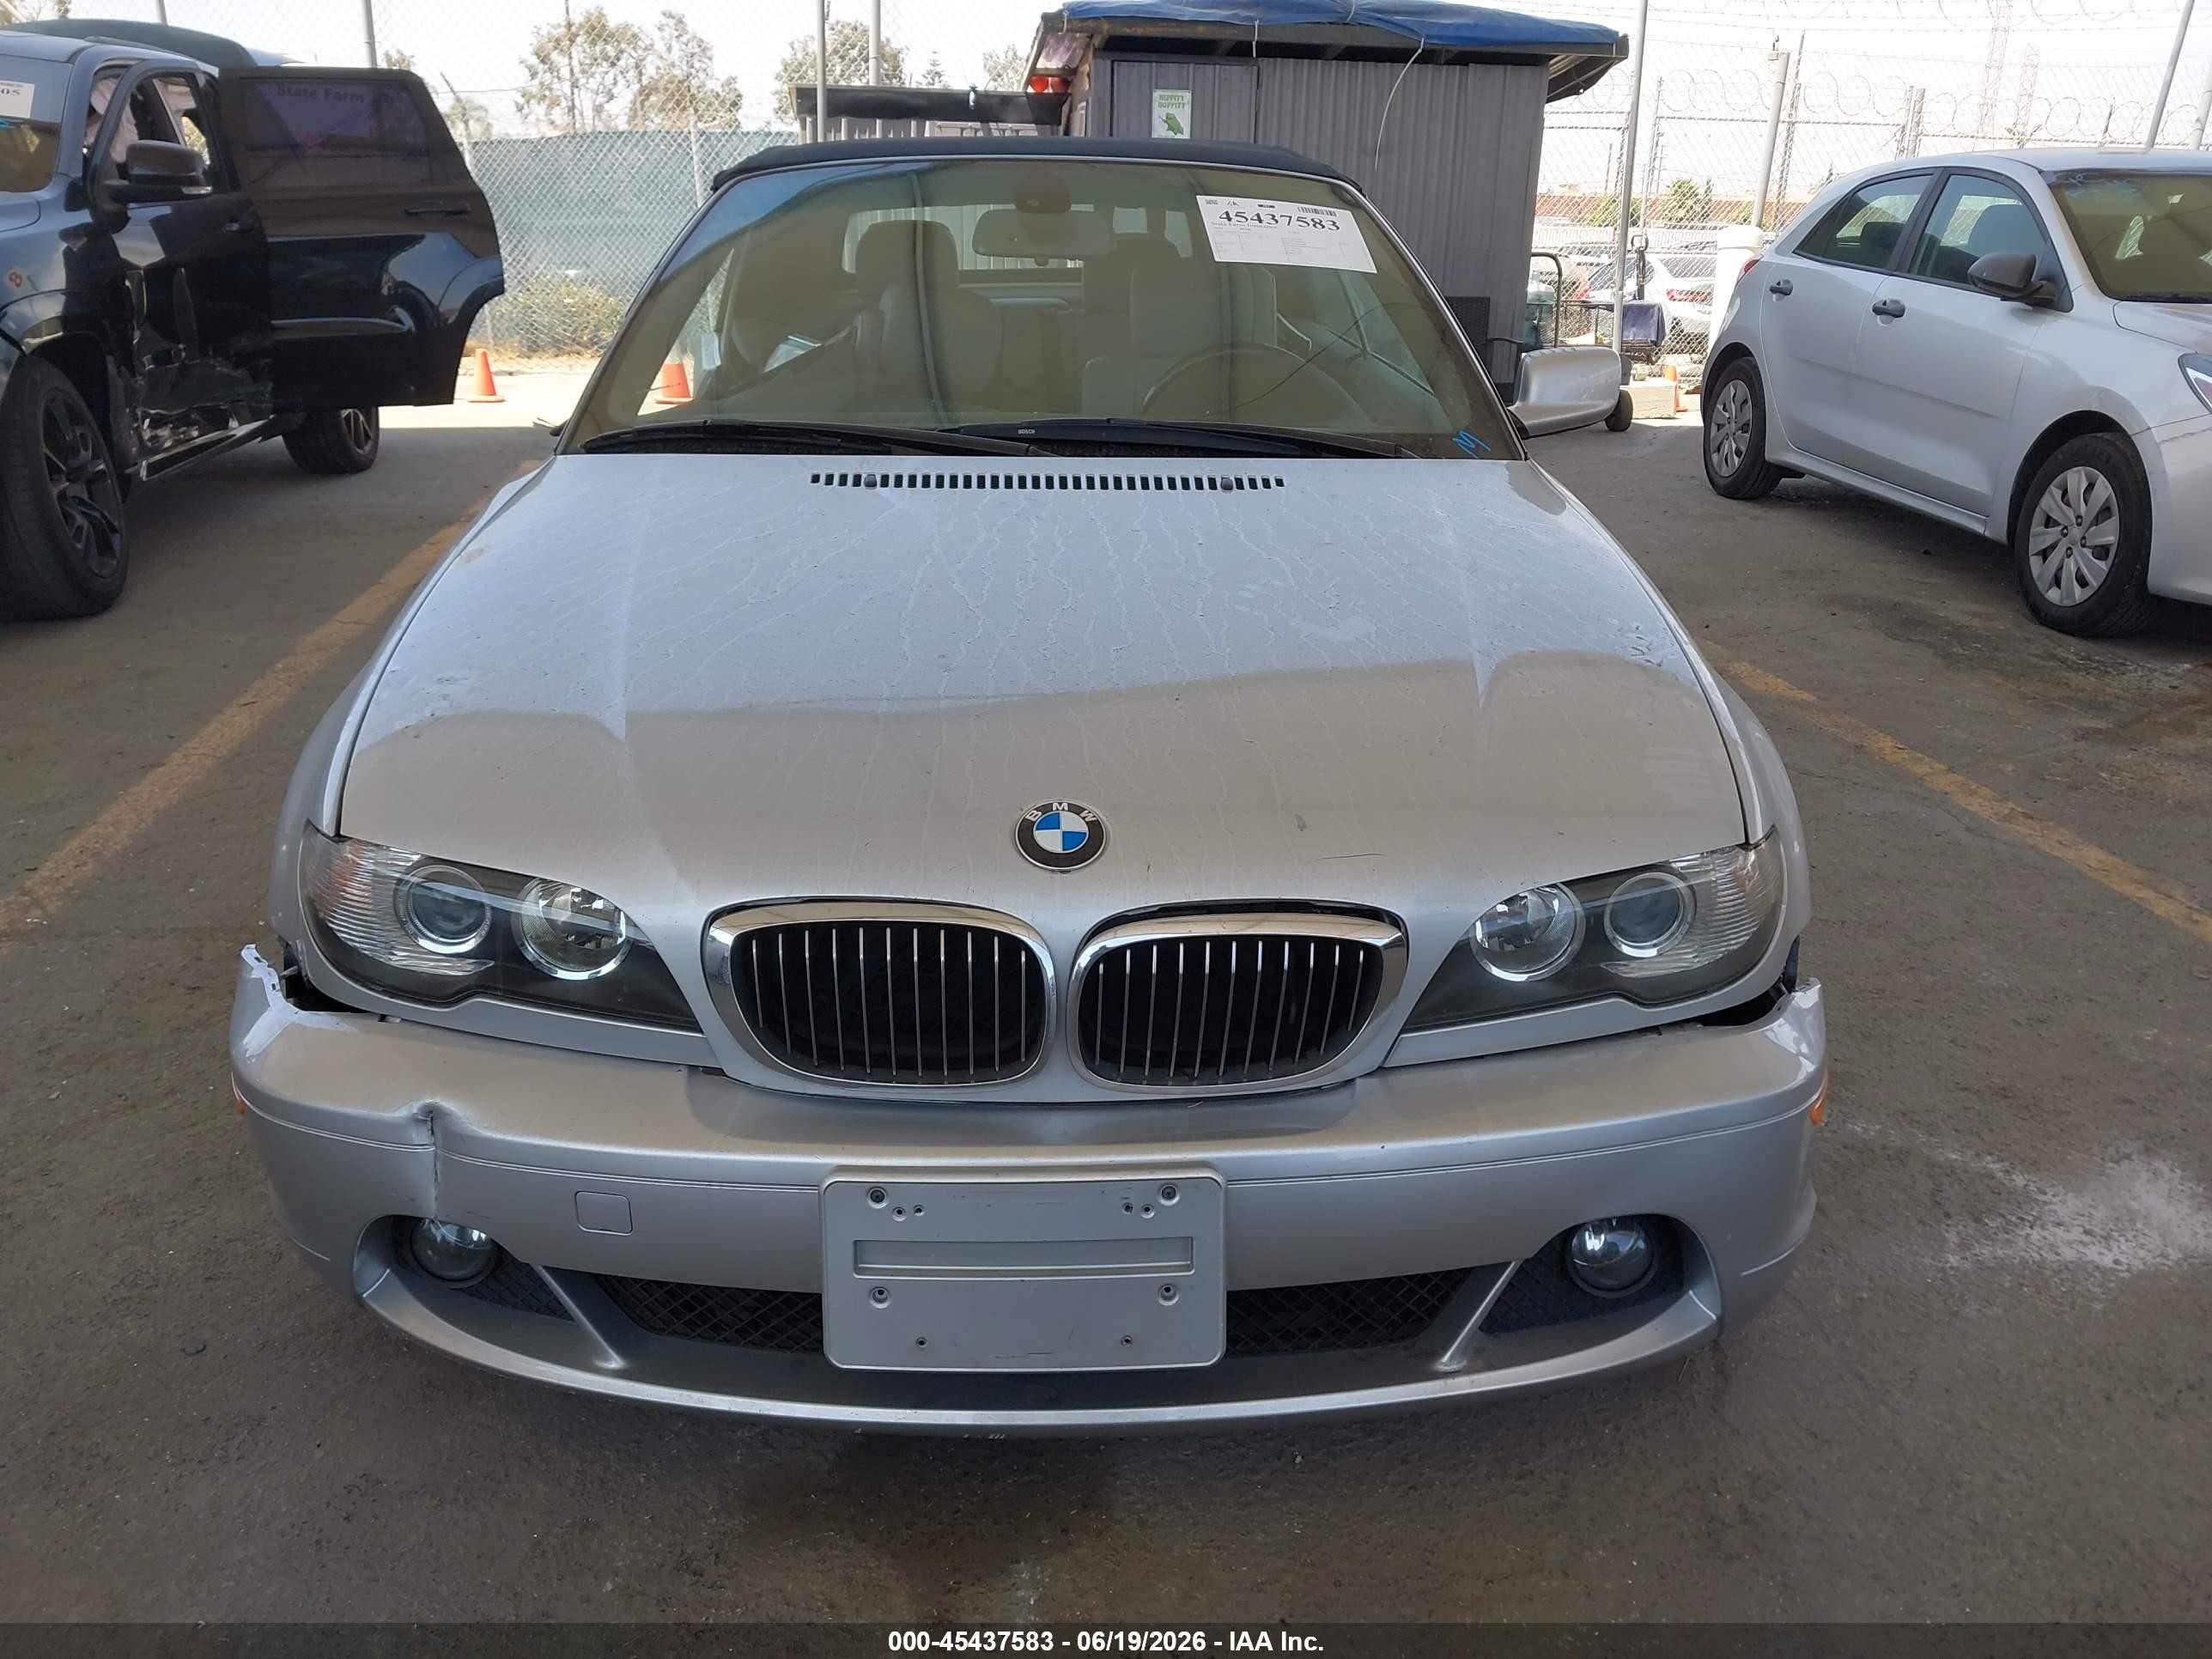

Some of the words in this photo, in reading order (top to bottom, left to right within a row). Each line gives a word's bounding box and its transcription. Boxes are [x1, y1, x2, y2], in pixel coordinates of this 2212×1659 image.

[276, 86, 318, 100] State
[324, 88, 365, 103] Farm
[1218, 210, 1340, 231] 45437583
[1024, 802, 1097, 823] BMW
